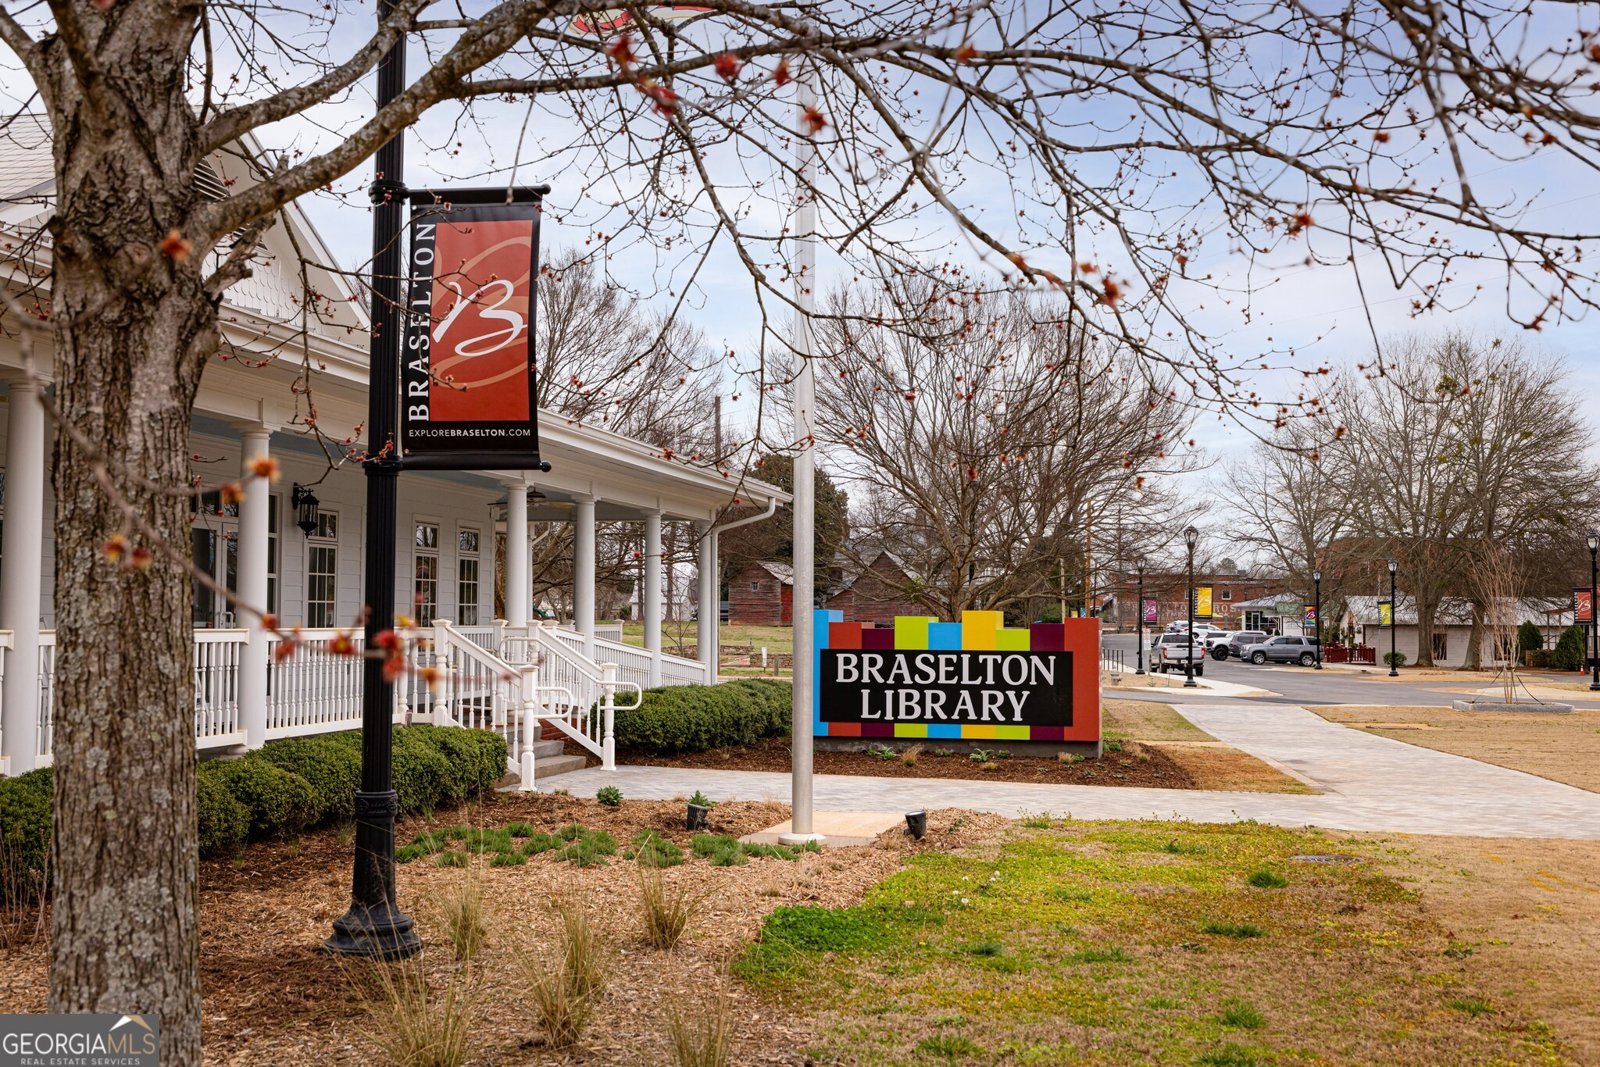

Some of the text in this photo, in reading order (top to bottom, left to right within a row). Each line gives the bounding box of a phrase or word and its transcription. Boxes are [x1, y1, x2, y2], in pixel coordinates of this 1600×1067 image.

[408, 223, 436, 422] BRASELTON
[408, 428, 531, 438] EXPLOREBRASELTON.COM
[835, 653, 1057, 686] BRASELTON
[860, 689, 1030, 722] LIBRARY
